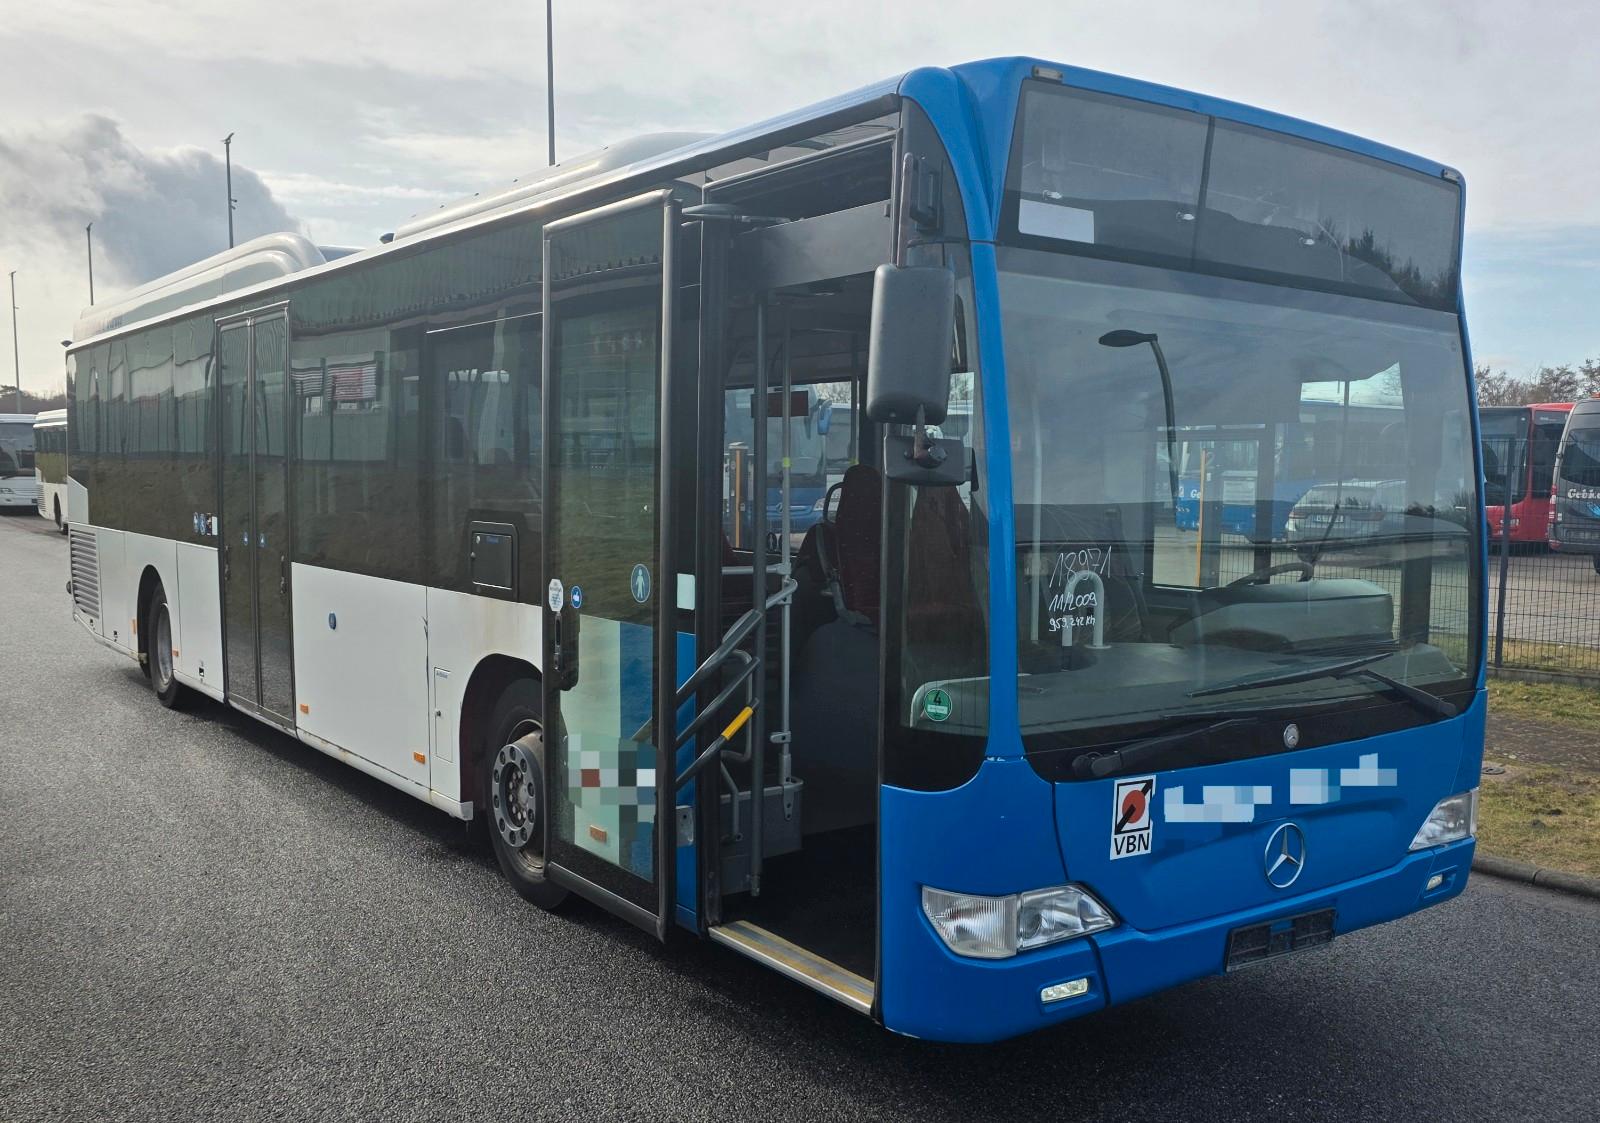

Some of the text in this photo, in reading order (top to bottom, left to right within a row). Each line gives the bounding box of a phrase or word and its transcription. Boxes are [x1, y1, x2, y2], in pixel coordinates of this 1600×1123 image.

[1048, 592, 1098, 612] 11/2009
[933, 690, 942, 705] 4
[1113, 832, 1150, 856] VBN
